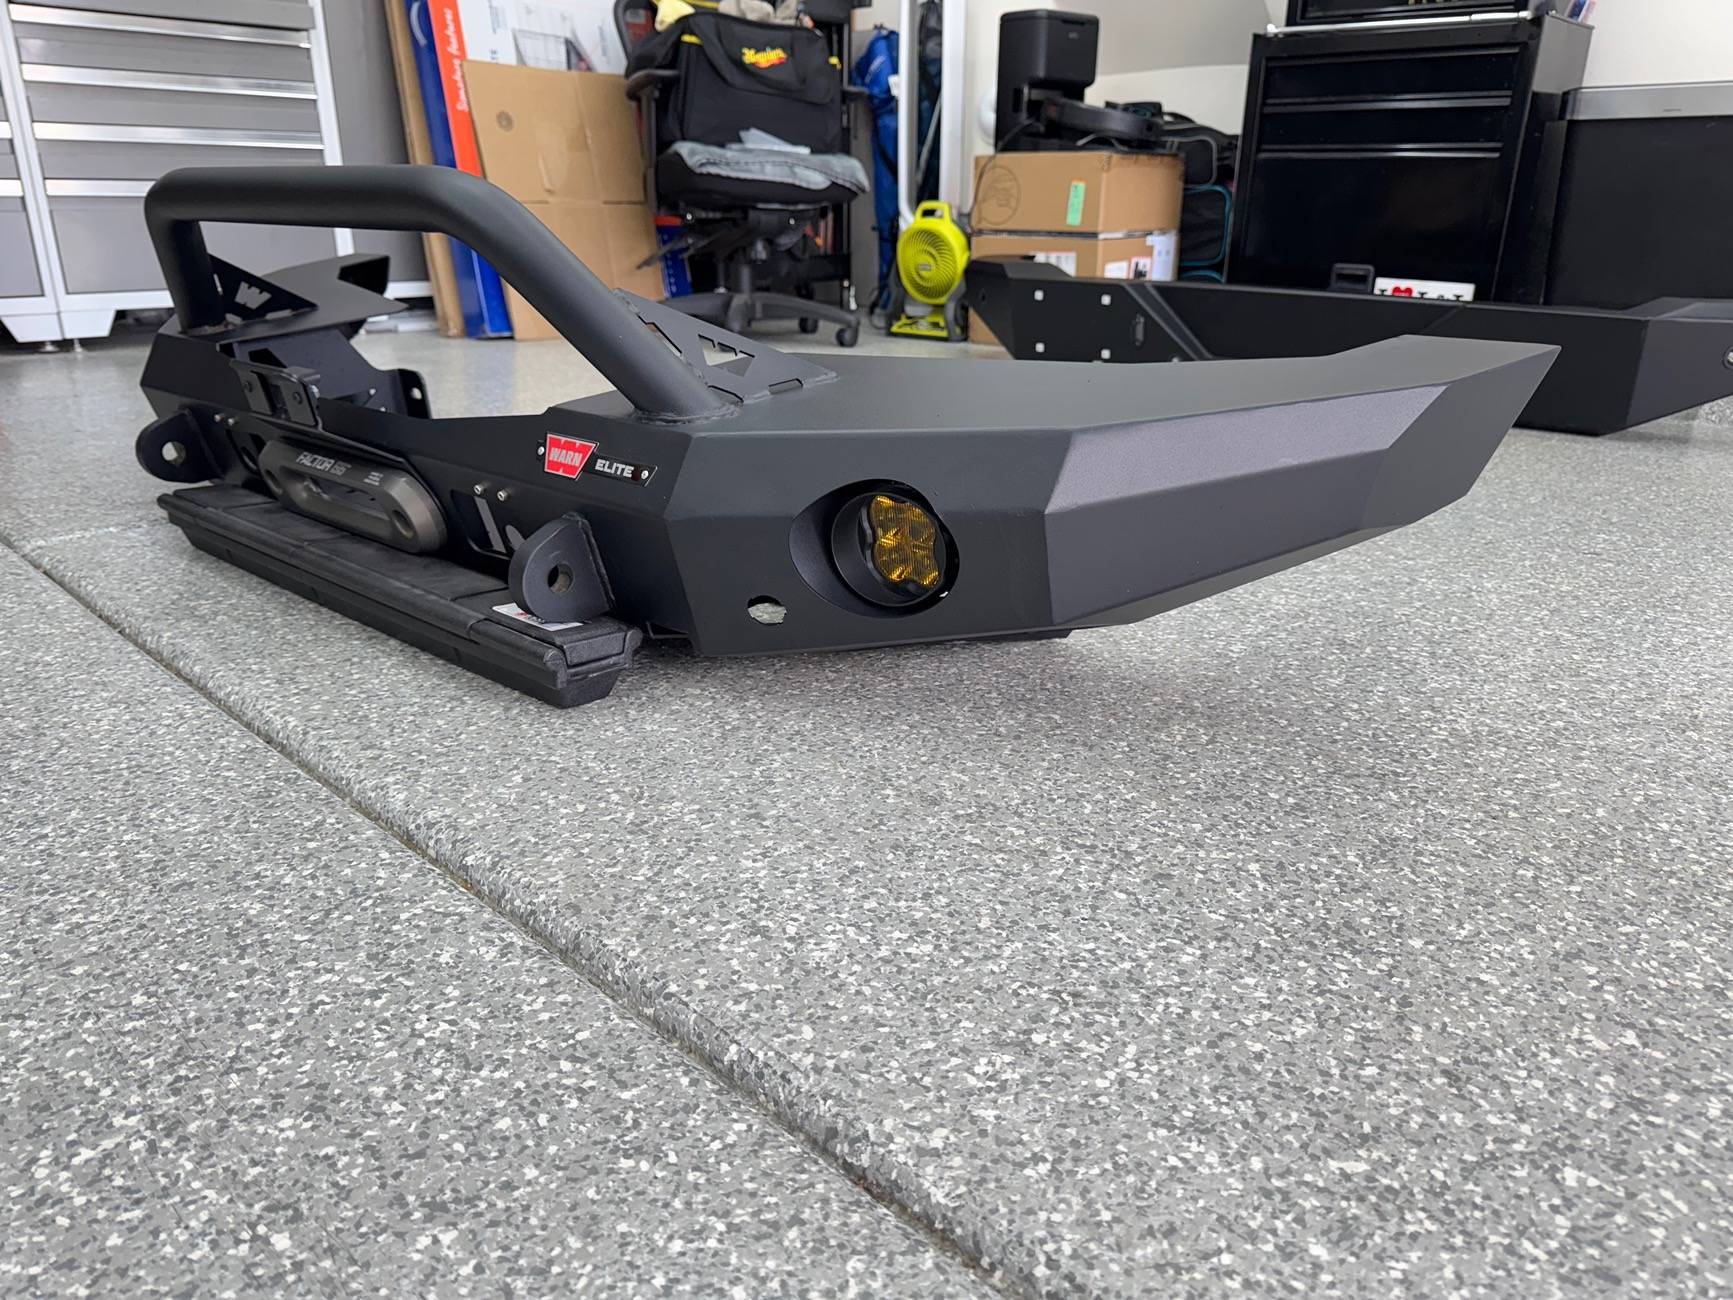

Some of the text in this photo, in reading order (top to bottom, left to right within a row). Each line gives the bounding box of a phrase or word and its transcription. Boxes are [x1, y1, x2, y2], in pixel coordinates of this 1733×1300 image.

[296, 452, 336, 472] FACTOR
[549, 447, 635, 478] WARN ELITE
